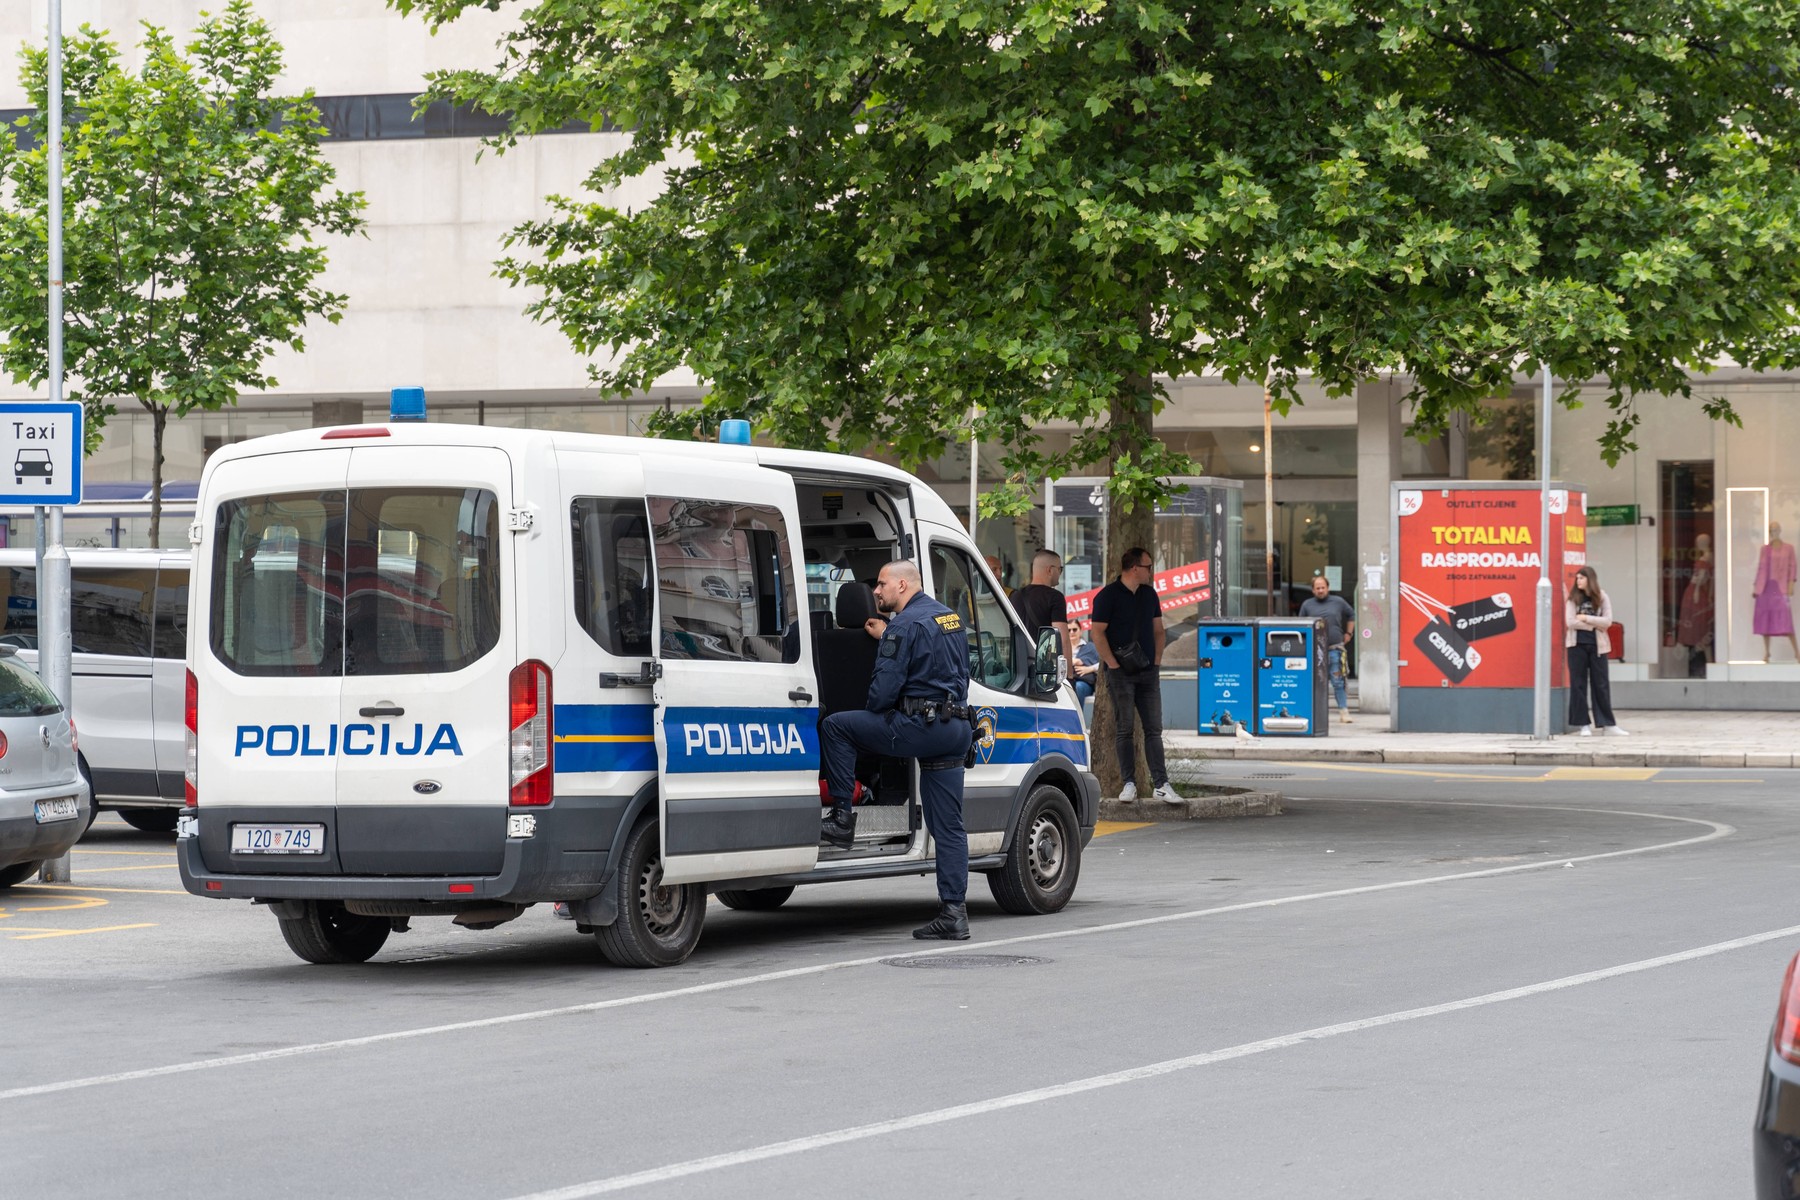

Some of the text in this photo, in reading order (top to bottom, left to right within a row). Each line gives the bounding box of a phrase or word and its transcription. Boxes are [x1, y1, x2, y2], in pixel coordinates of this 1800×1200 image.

[12, 422, 55, 439] Taxi
[1446, 500, 1517, 508] OUTLET CIJENE
[1431, 525, 1532, 545] TOTALNA
[1421, 552, 1541, 568] RASPRODAJA
[1173, 569, 1206, 588] SALE
[1468, 573, 1516, 581] ZATVARANJA
[1066, 597, 1090, 615] ALE
[1468, 609, 1509, 626] TOP SPORT
[1428, 632, 1465, 670] CENTRA
[234, 723, 464, 757] POLICIJA
[683, 723, 806, 756] POLICIJA
[247, 829, 311, 848] 120 749
